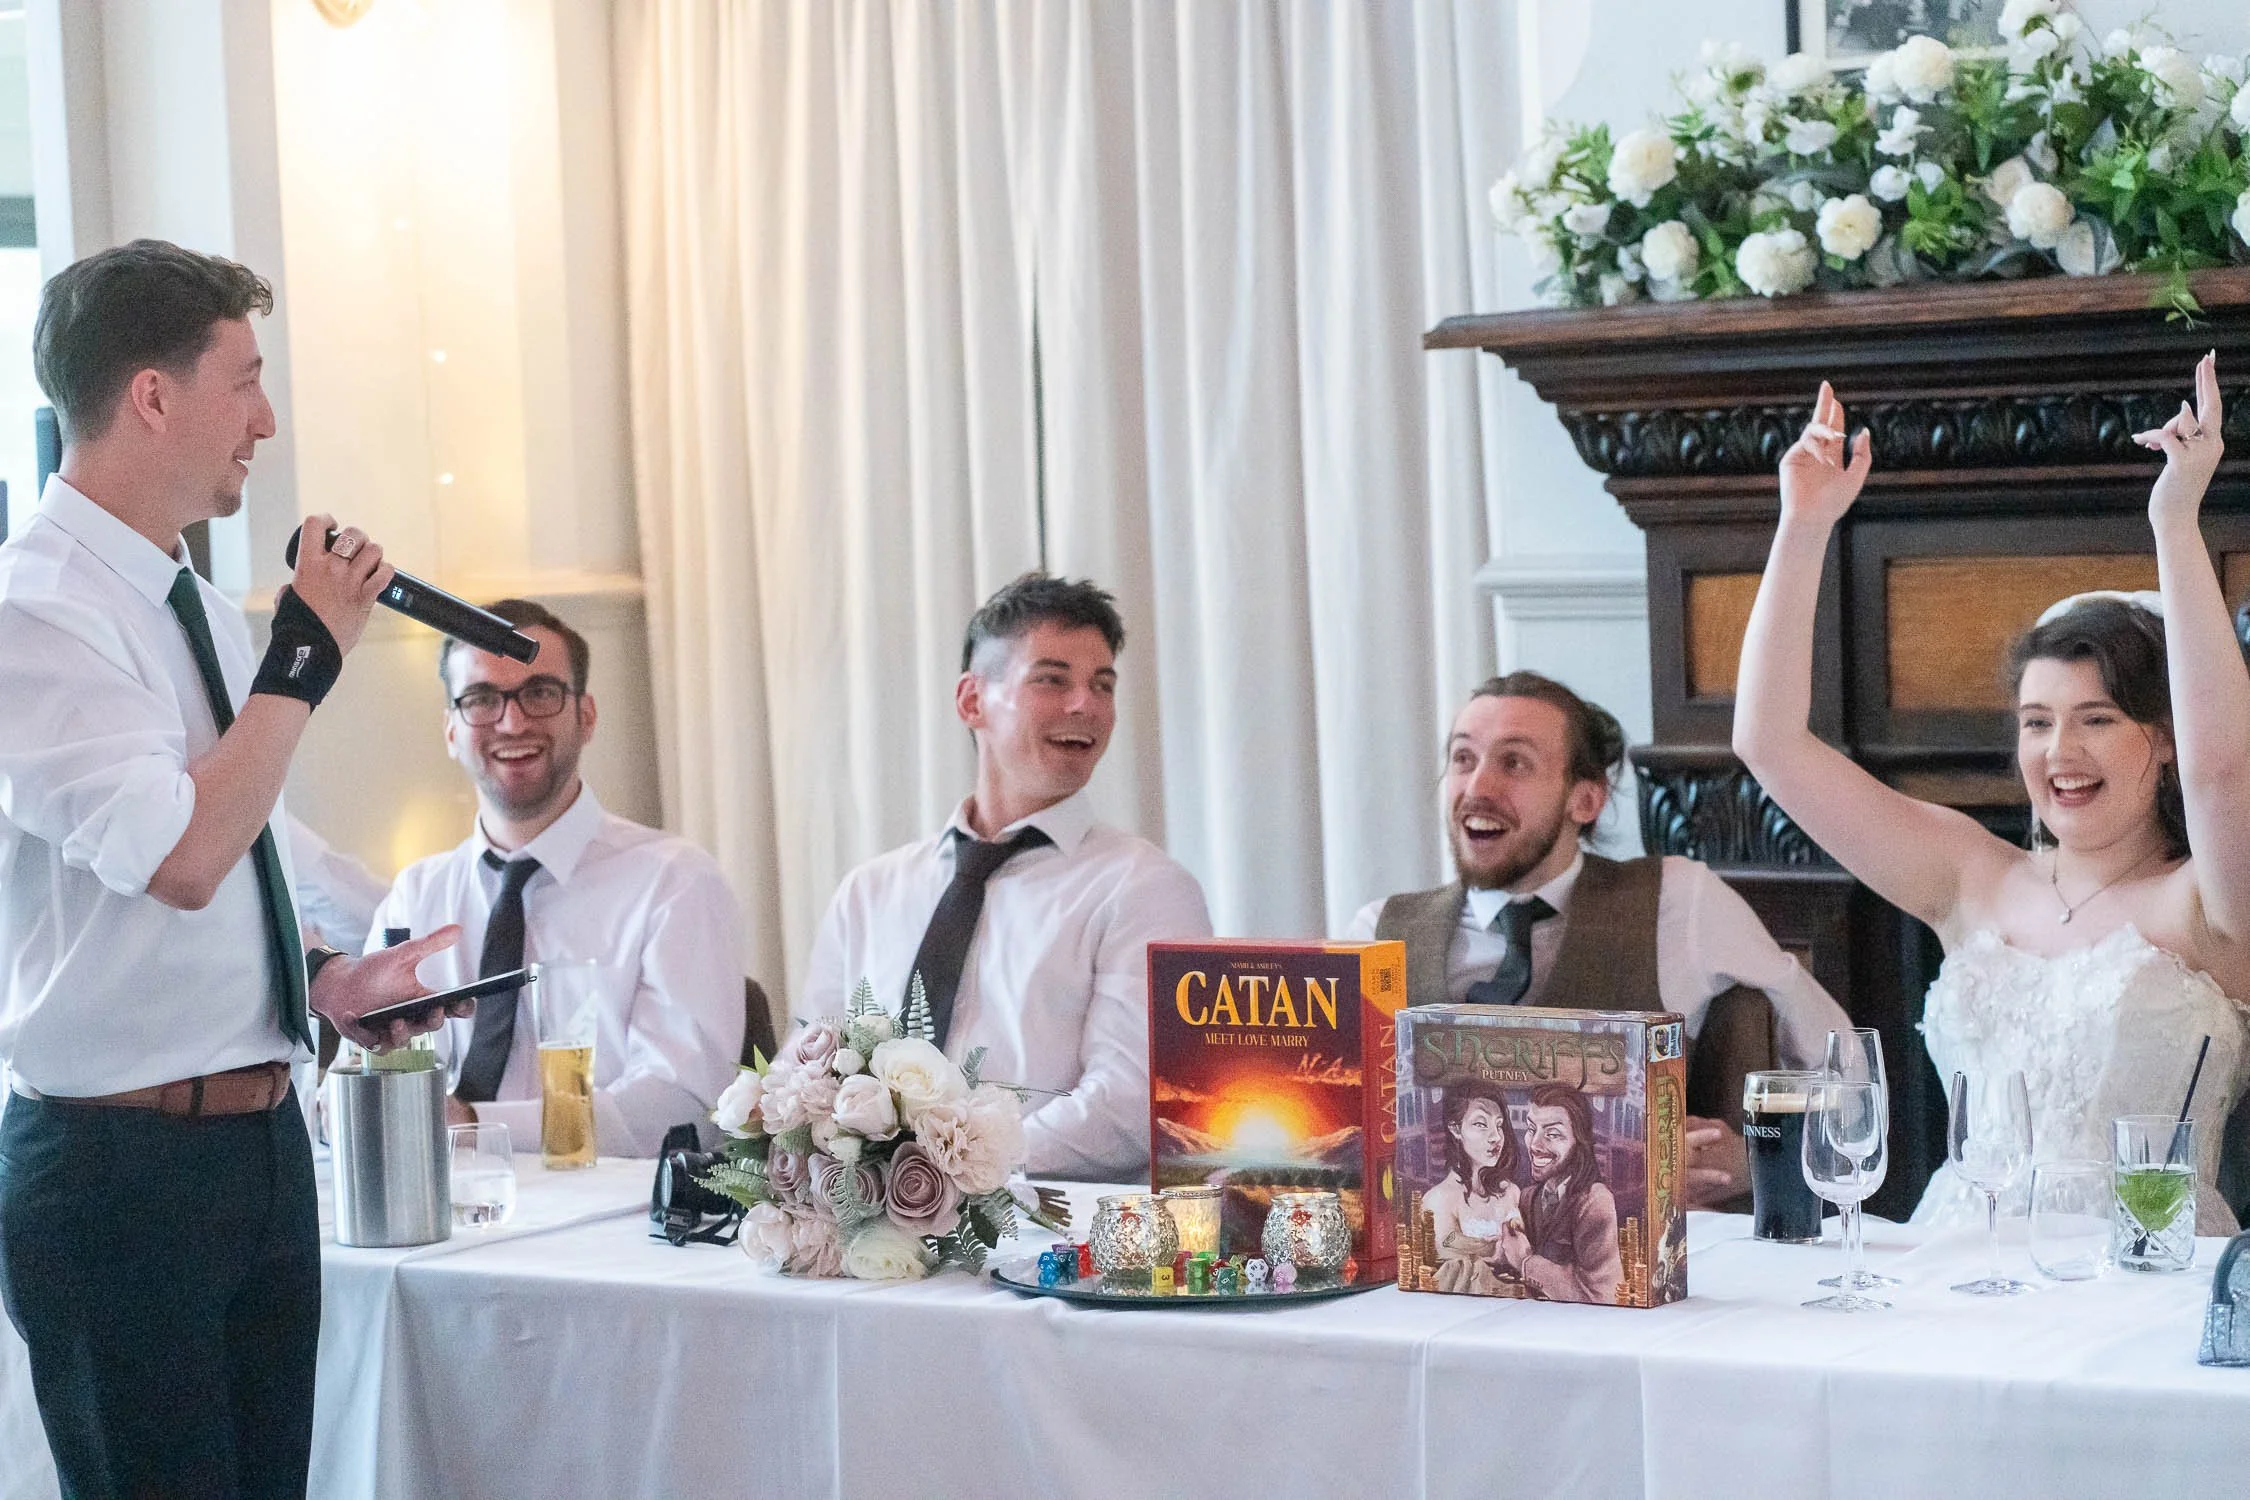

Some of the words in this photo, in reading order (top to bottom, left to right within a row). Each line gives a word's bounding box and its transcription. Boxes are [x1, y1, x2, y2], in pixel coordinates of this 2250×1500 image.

[1175, 970, 1340, 1030] CATAN
[1205, 1032, 1235, 1045] MEET
[1238, 1033, 1268, 1046] LOVE
[1271, 1034, 1310, 1047] MARRY
[1482, 1069, 1528, 1081] PUTNEY
[1380, 1024, 1397, 1144] CATAN
[1743, 1124, 1781, 1138] UINNESS
